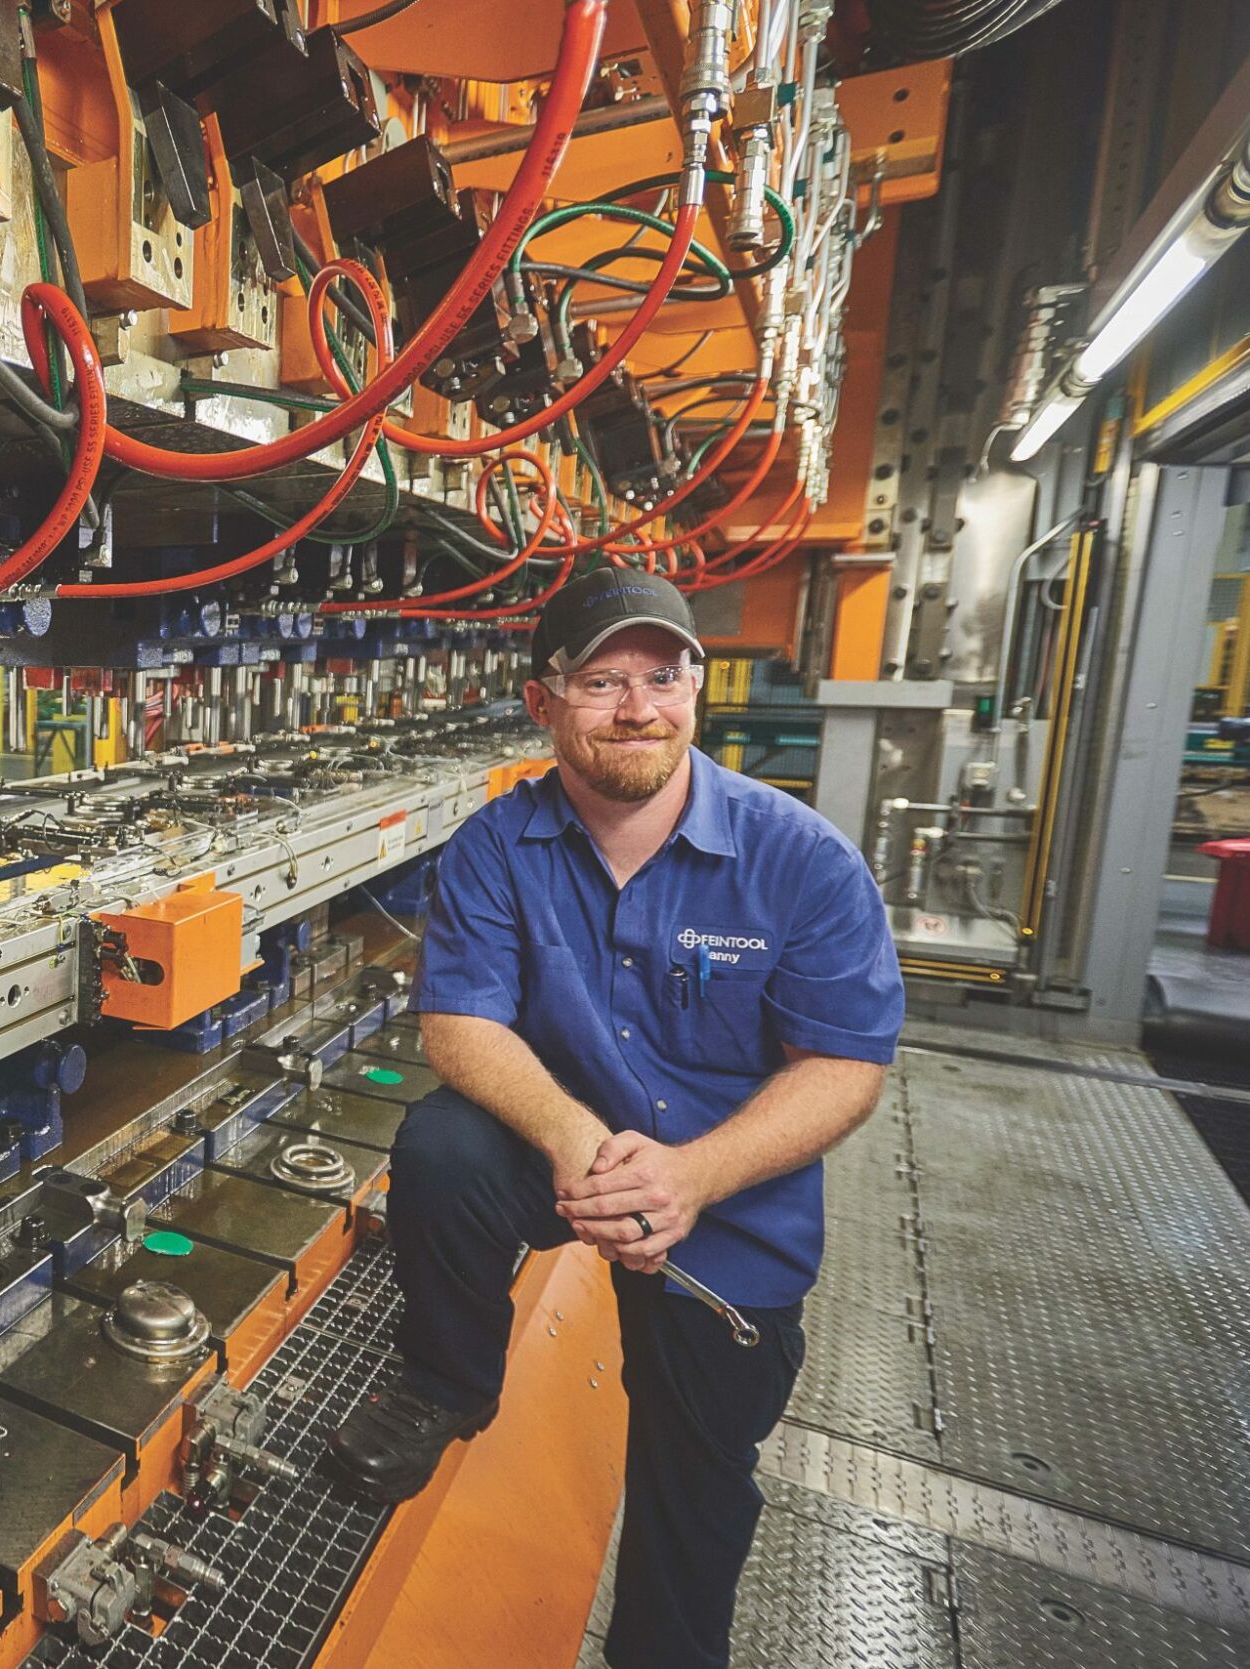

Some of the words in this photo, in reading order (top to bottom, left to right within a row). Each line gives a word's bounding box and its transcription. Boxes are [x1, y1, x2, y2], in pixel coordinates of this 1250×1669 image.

[469, 261, 501, 311] SERIES
[86, 402, 100, 438] SERIES
[700, 934, 769, 951] FEINTOOL
[708, 951, 740, 964] anny
